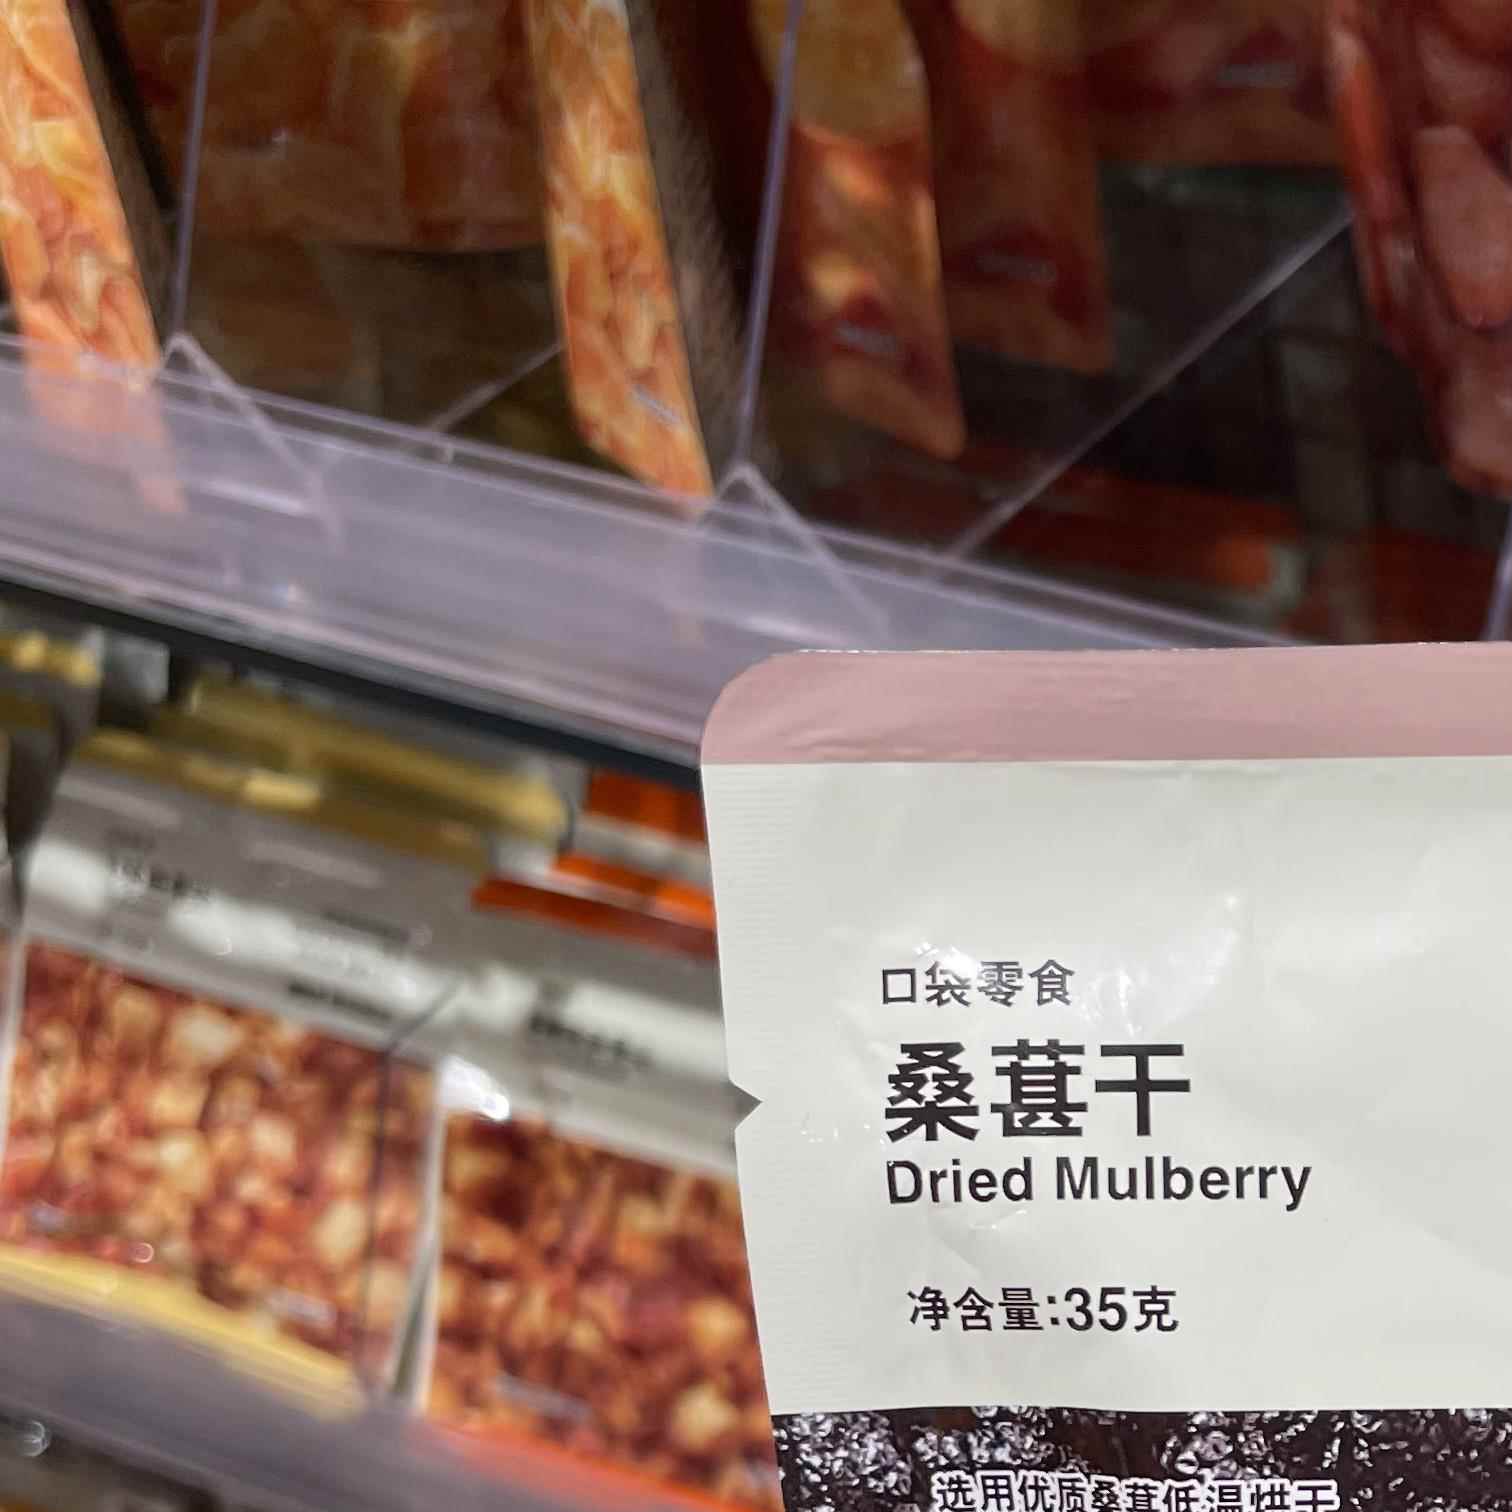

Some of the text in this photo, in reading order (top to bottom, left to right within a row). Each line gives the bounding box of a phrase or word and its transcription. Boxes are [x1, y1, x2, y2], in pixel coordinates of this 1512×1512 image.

[882, 959, 1075, 1008] 口袋零食
[885, 1038, 1191, 1143] 桑葚干
[886, 1156, 1312, 1211] Dried Mulberry
[908, 1285, 1179, 1332] 净含量:35克
